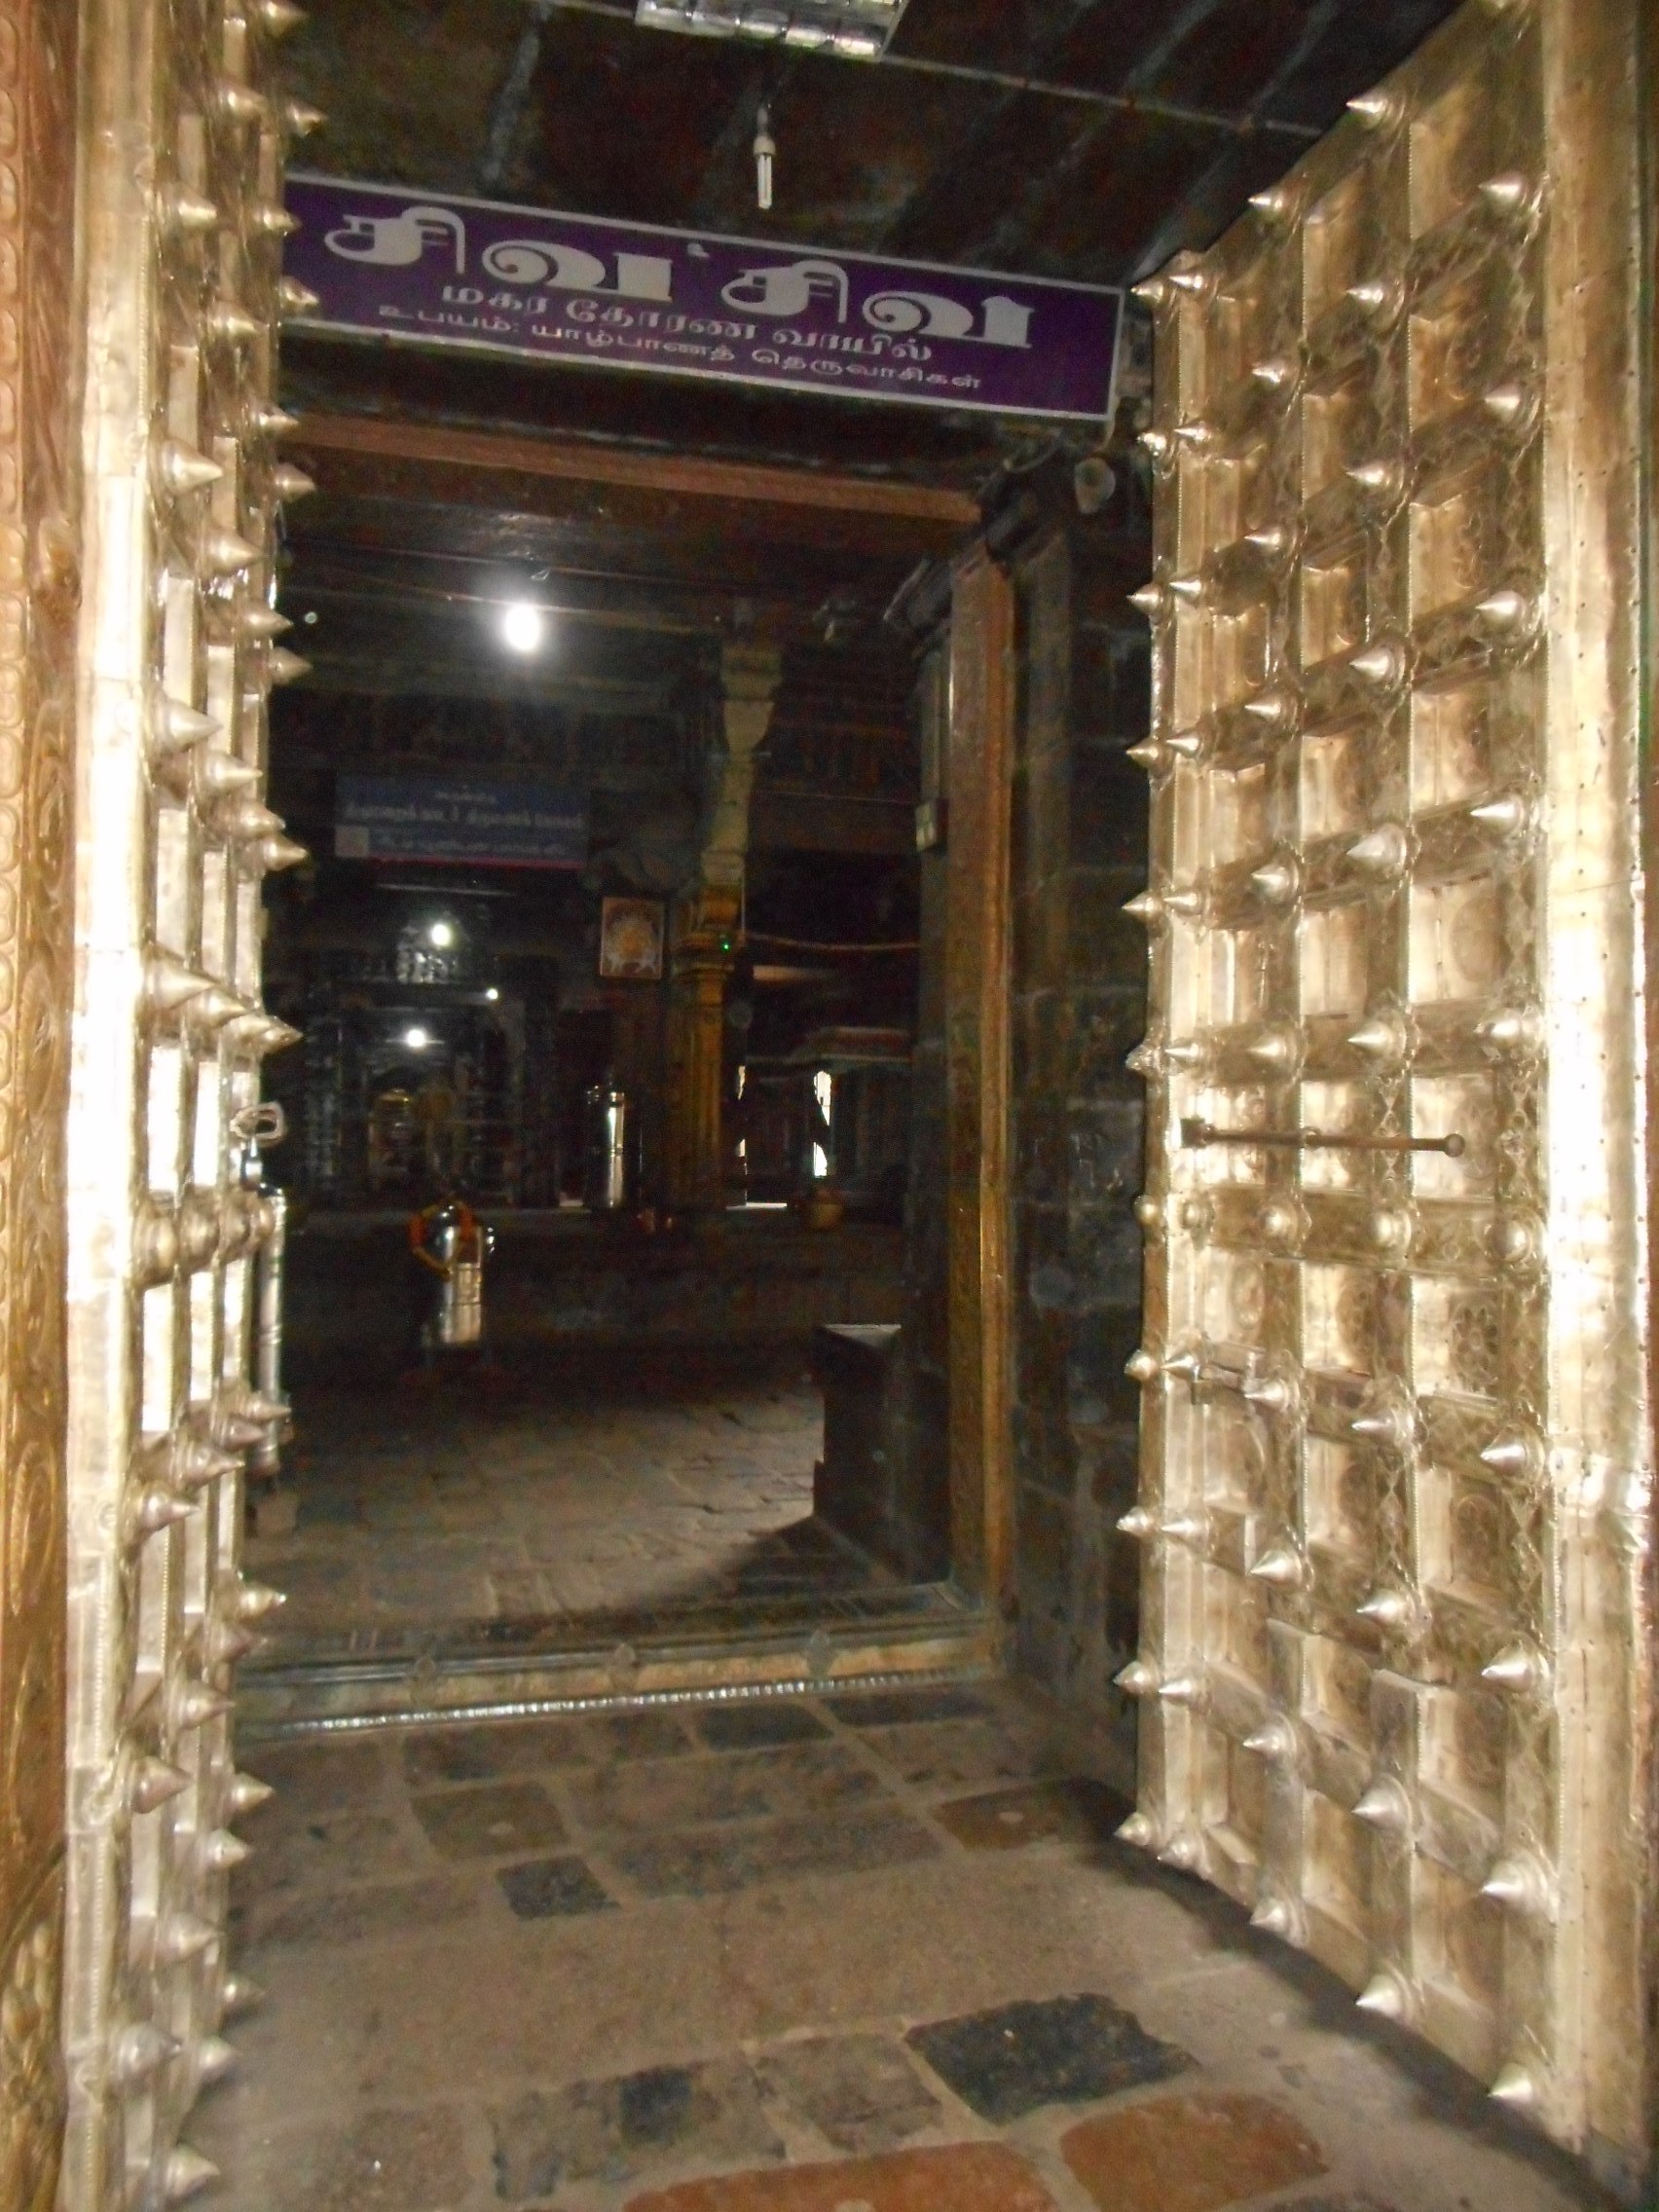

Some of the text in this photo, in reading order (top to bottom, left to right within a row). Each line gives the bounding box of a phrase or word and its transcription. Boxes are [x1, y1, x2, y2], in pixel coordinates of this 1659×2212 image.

[324, 205, 1035, 349] சிவ சிவ
[441, 285, 550, 317] மகர
[772, 328, 933, 361] வாயில்
